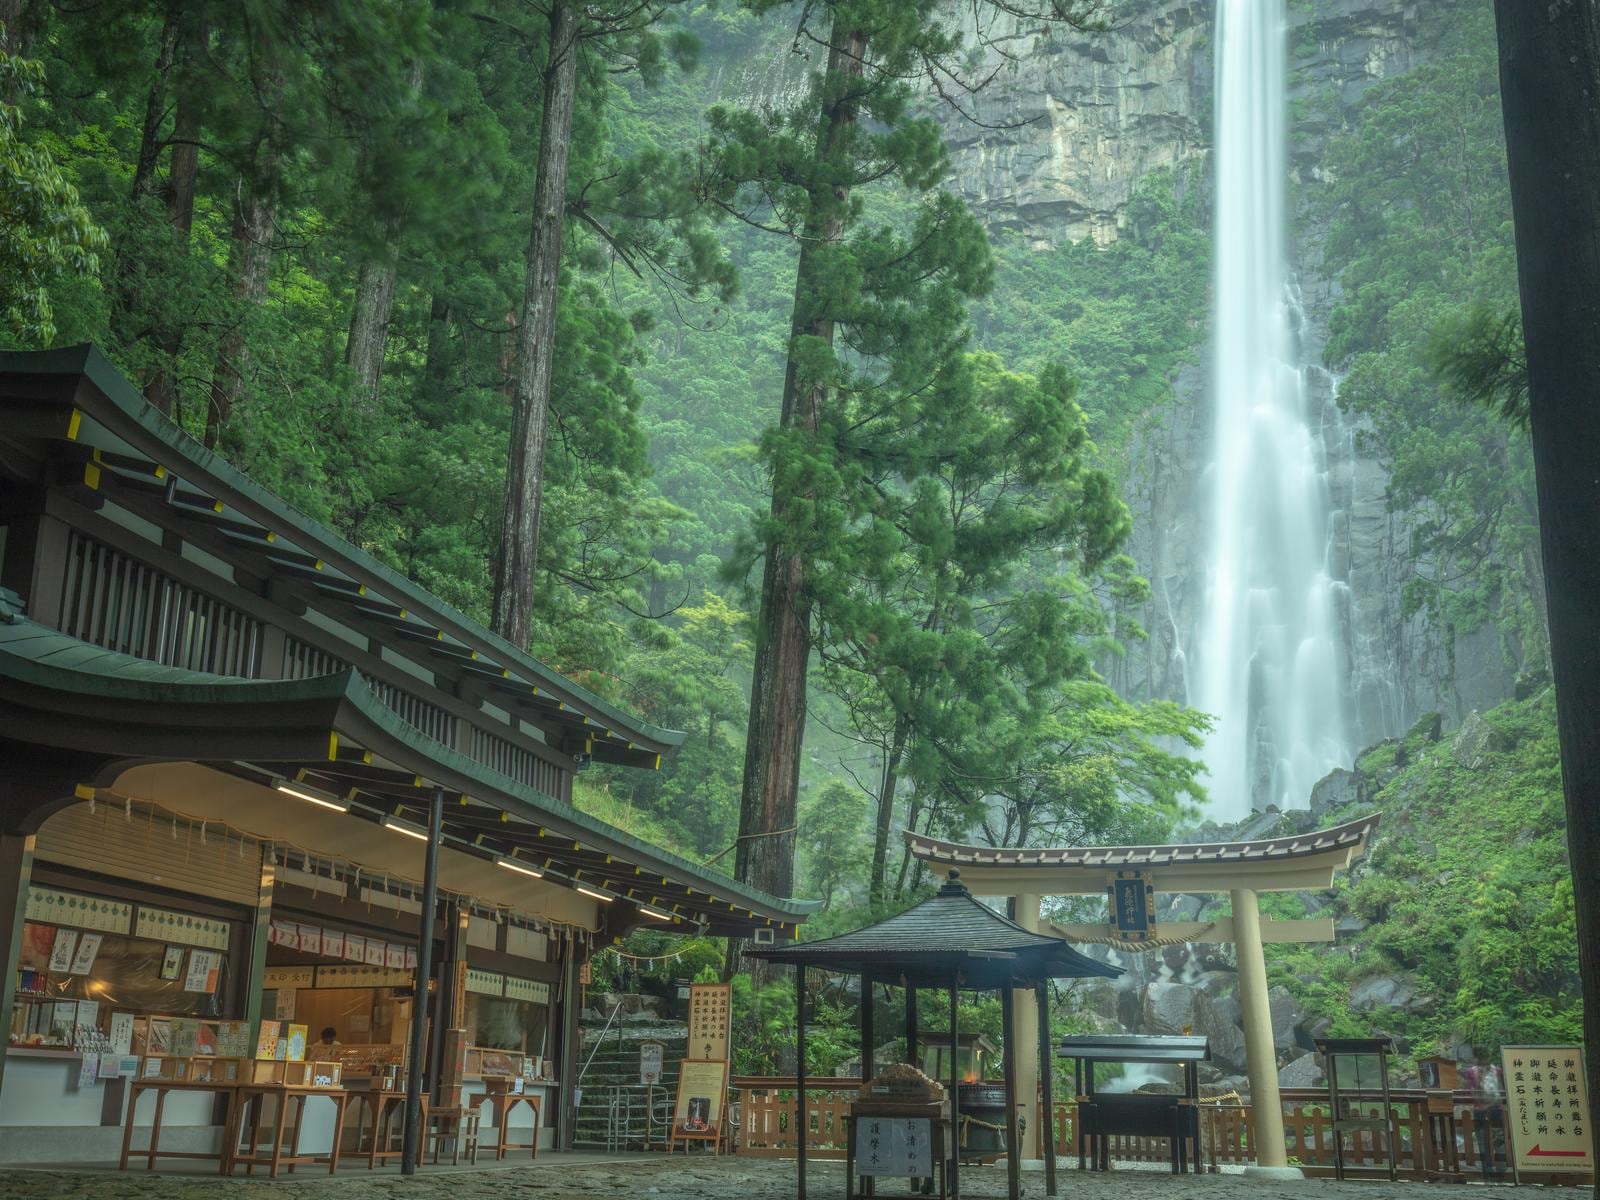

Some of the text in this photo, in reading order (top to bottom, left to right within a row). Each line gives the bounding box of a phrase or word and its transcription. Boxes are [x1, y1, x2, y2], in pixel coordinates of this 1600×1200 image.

[1547, 1059, 1565, 1136] 延命長寿の水
[870, 1122, 881, 1165] 護摩木
[906, 1119, 917, 1174] お清めの
